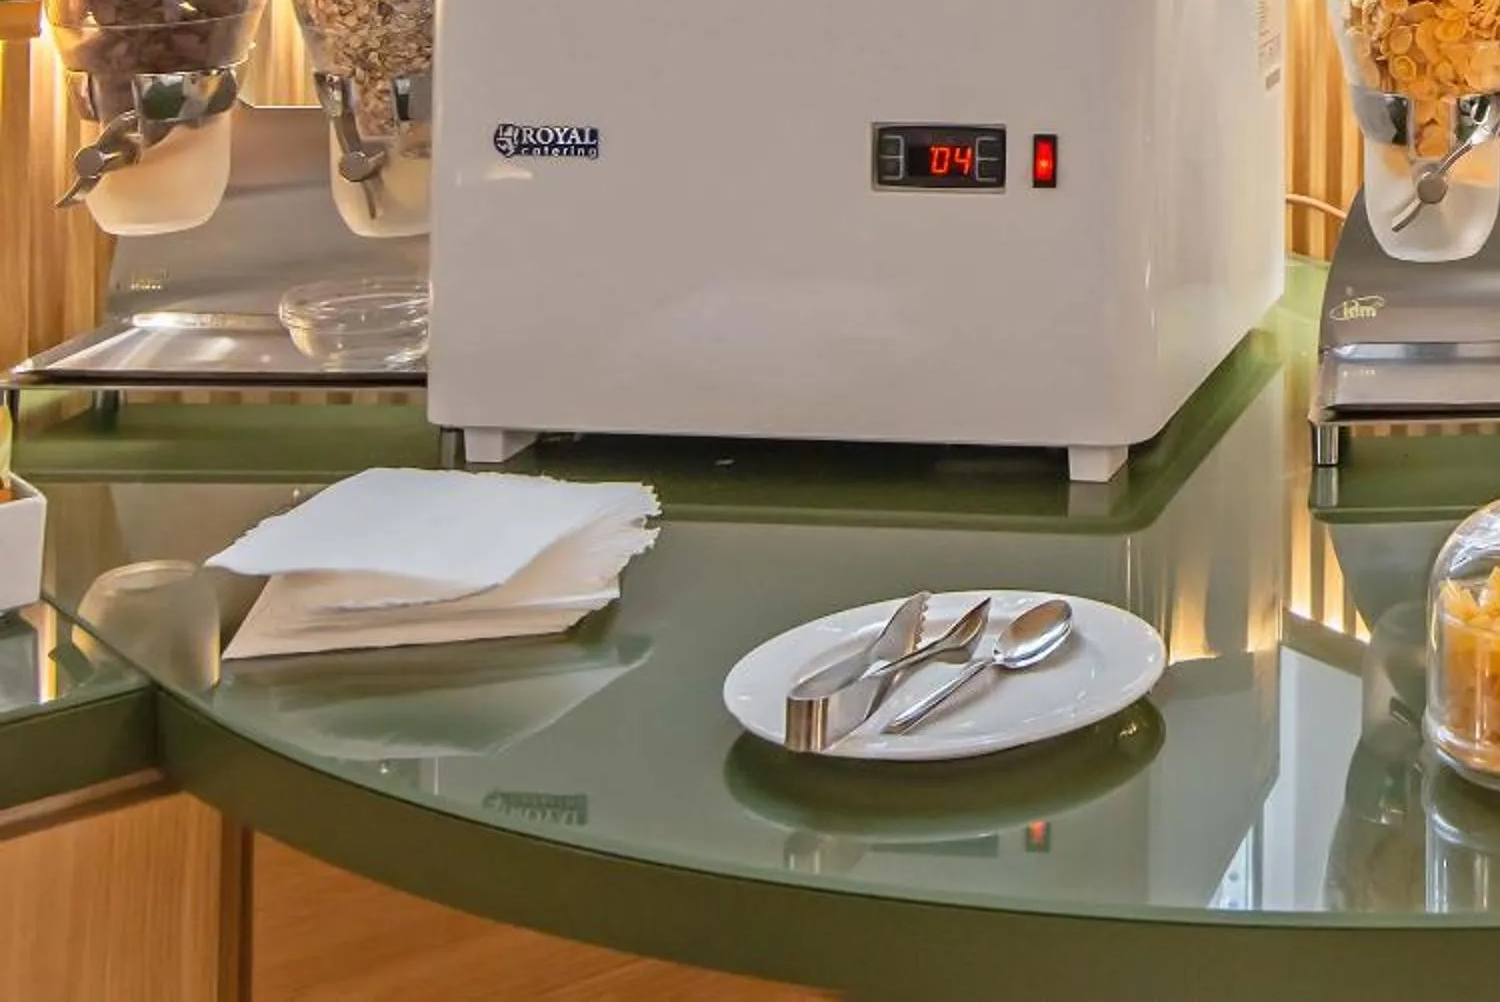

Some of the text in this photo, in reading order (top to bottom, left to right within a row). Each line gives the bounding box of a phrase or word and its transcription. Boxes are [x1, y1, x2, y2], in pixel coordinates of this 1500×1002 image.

[521, 127, 598, 145] ROYAL
[521, 145, 598, 159] catering
[930, 146, 973, 175] 04
